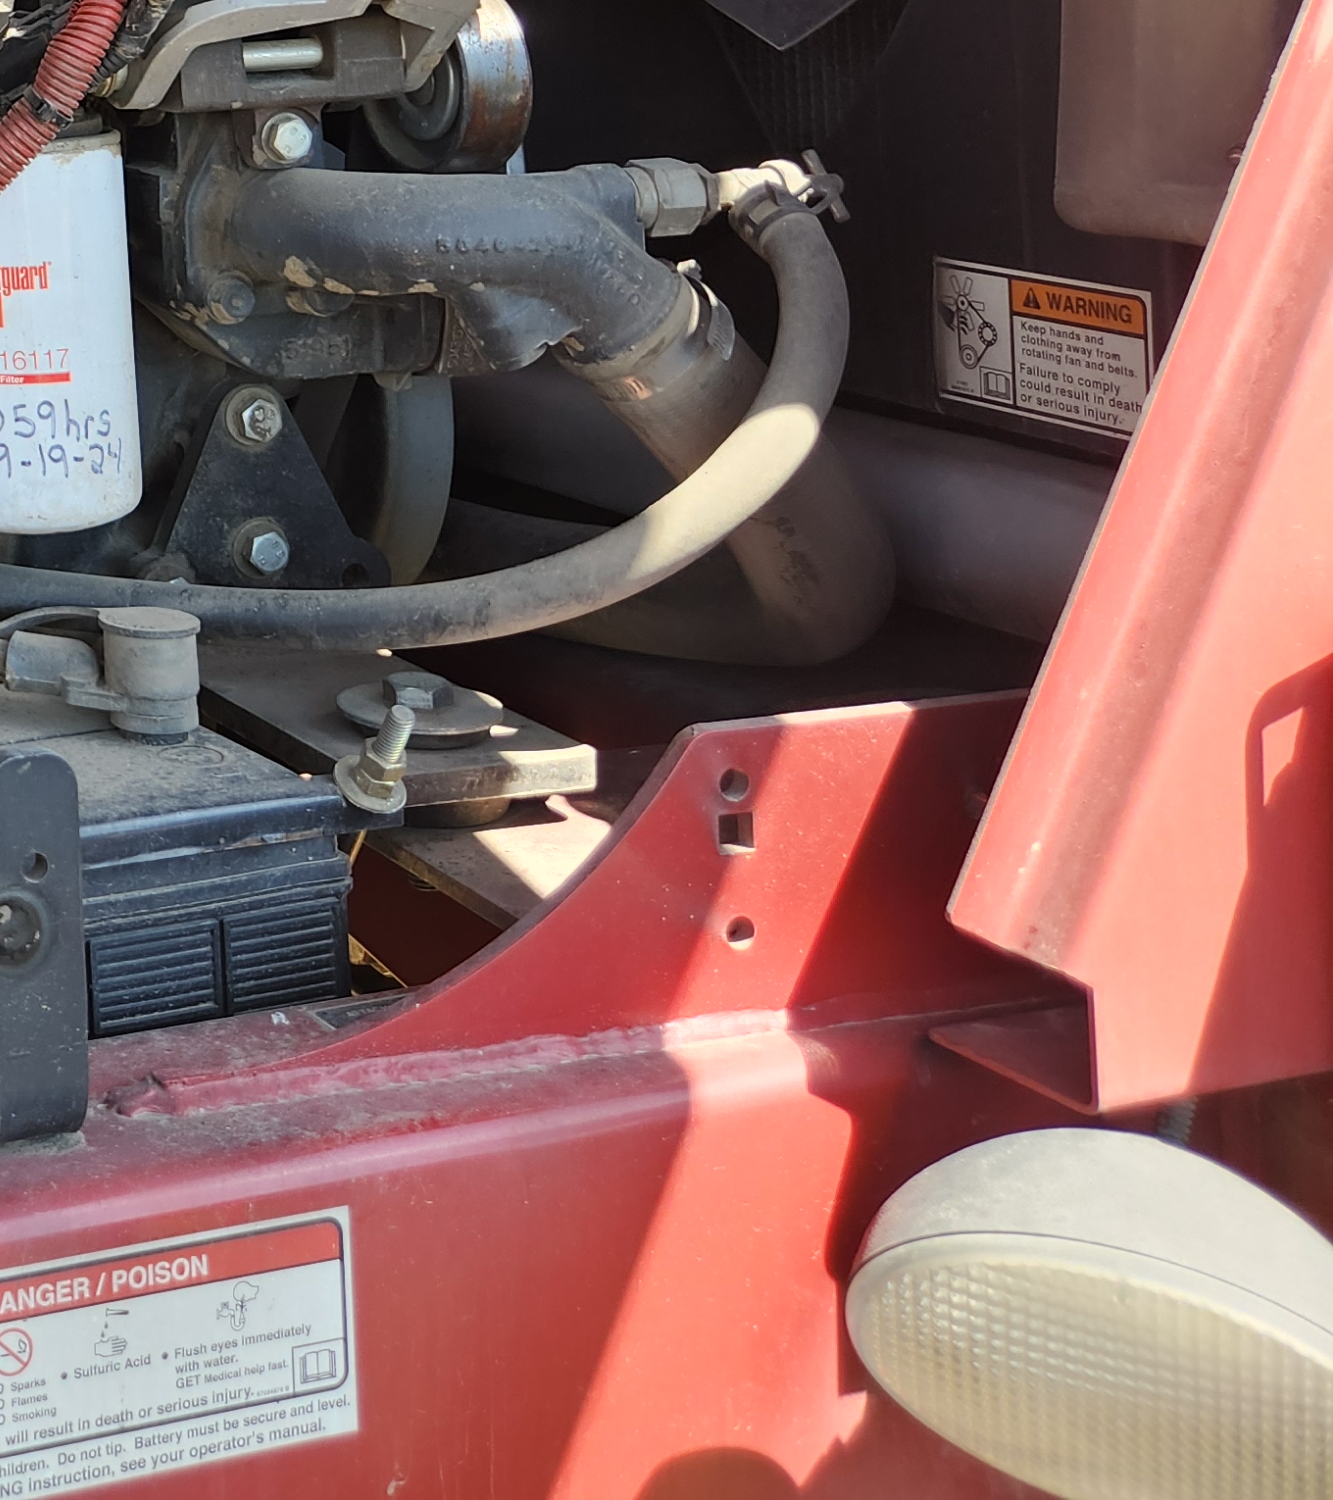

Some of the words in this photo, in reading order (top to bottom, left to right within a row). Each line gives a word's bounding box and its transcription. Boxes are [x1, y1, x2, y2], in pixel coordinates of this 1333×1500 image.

[1045, 291, 1132, 324] WARNING
[1020, 321, 1047, 337] Keep
[1049, 326, 1081, 342] hands
[1084, 335, 1104, 346] and
[1020, 334, 1063, 353] clothing
[1065, 343, 1093, 359] away
[1095, 348, 1121, 362] from
[0, 374, 25, 384] Filter
[1021, 346, 1062, 365] rotating
[1064, 354, 1082, 368] fan
[1084, 360, 1104, 372] and
[1107, 364, 1138, 379] belts.
[1018, 362, 1059, 381] Failure
[1061, 371, 1074, 384] to
[1077, 376, 1121, 397] comply
[1019, 379, 1052, 394] could
[1054, 384, 1090, 403] result
[1093, 392, 1104, 405] in
[1108, 397, 1143, 414] death
[1020, 392, 1033, 403] or
[1036, 396, 1080, 415] serious
[1083, 405, 1124, 425] injury.
[94, 1272, 107, 1296] /
[111, 1253, 210, 1293] POISON
[174, 1343, 207, 1360] Flush
[210, 1337, 239, 1352] eyes
[241, 1323, 312, 1346] immediately
[73, 1361, 121, 1380] Sulfuric
[124, 1353, 152, 1370] Acid
[174, 1359, 200, 1374] with
[203, 1353, 239, 1369] water.
[175, 1374, 201, 1389] GET
[203, 1367, 242, 1384] Medical
[244, 1363, 266, 1377] help
[267, 1358, 290, 1372] fast.
[10, 1376, 47, 1393] Sparks
[11, 1392, 49, 1408] Flames
[5, 1428, 29, 1447] will
[33, 1420, 74, 1440] result
[77, 1417, 91, 1432] in
[95, 1407, 134, 1429] death
[137, 1404, 153, 1418] or
[156, 1393, 208, 1416] serious
[211, 1384, 255, 1408] injury.
[11, 1406, 58, 1424] Smoking
[57, 1451, 77, 1466] Do
[79, 1444, 102, 1462] not
[105, 1441, 127, 1458] tip.
[133, 1429, 183, 1450] Battery
[186, 1420, 220, 1439] must
[223, 1418, 240, 1431] be
[242, 1409, 287, 1428] secure
[289, 1401, 314, 1418] and
[317, 1393, 351, 1413] level.
[119, 1456, 147, 1474] see
[150, 1448, 185, 1470] your
[189, 1430, 265, 1460] operator's
[268, 1417, 327, 1442] manual.
